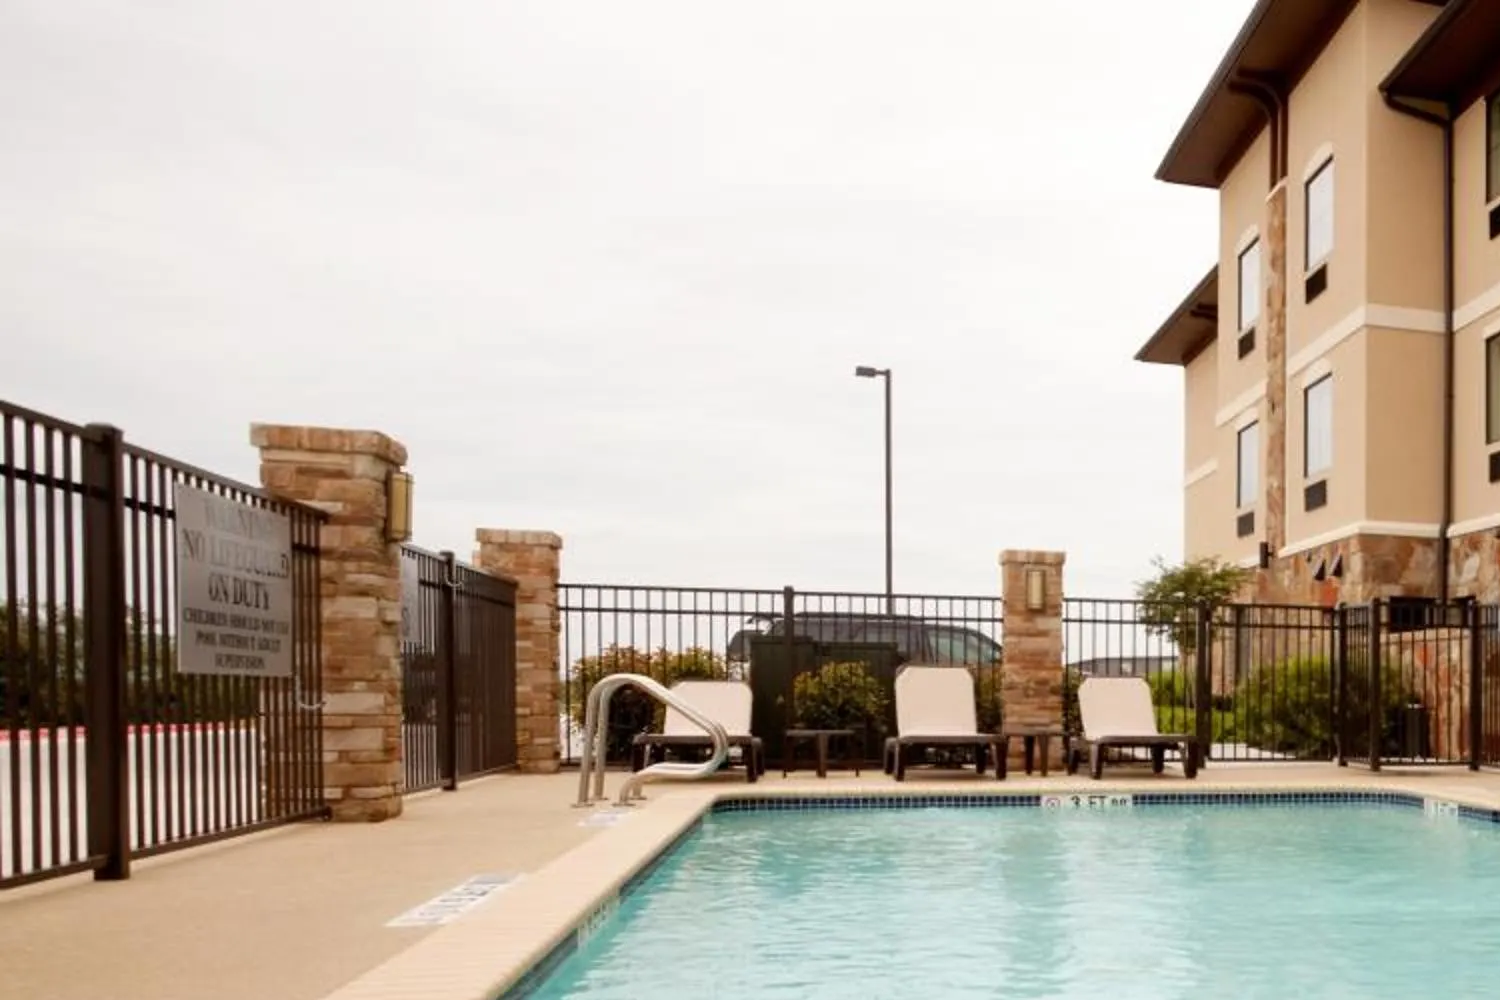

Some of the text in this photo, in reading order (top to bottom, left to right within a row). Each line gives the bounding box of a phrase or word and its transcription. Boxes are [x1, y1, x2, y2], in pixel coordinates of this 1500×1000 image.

[182, 528, 206, 563] NO
[208, 571, 270, 611] ON DUTY
